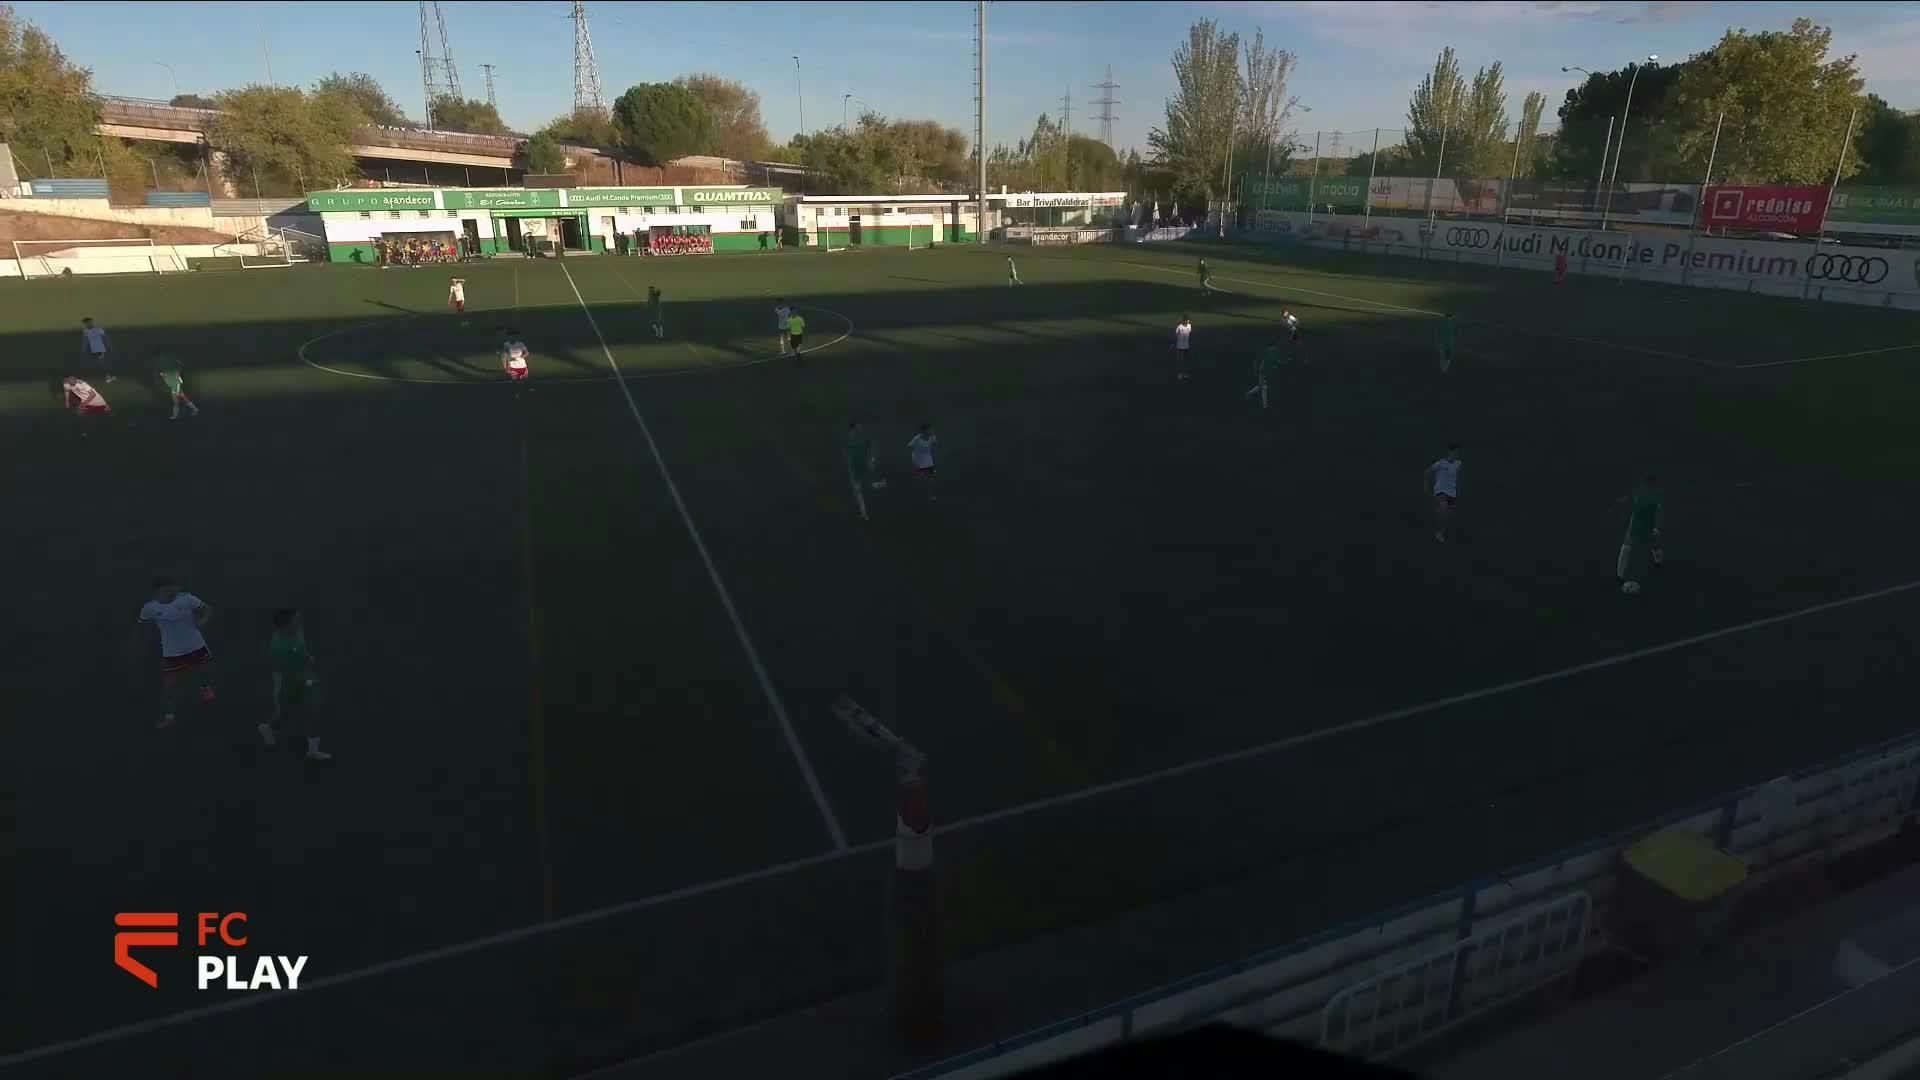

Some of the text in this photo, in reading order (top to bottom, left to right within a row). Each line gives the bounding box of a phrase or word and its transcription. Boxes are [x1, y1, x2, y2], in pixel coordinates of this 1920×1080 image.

[383, 196, 432, 209] afandecor
[694, 191, 771, 201] QUAMTRAX
[1016, 198, 1031, 207] Bar
[1746, 197, 1812, 215] redpiso
[1493, 231, 1798, 276] Audi M.Conde Premium
